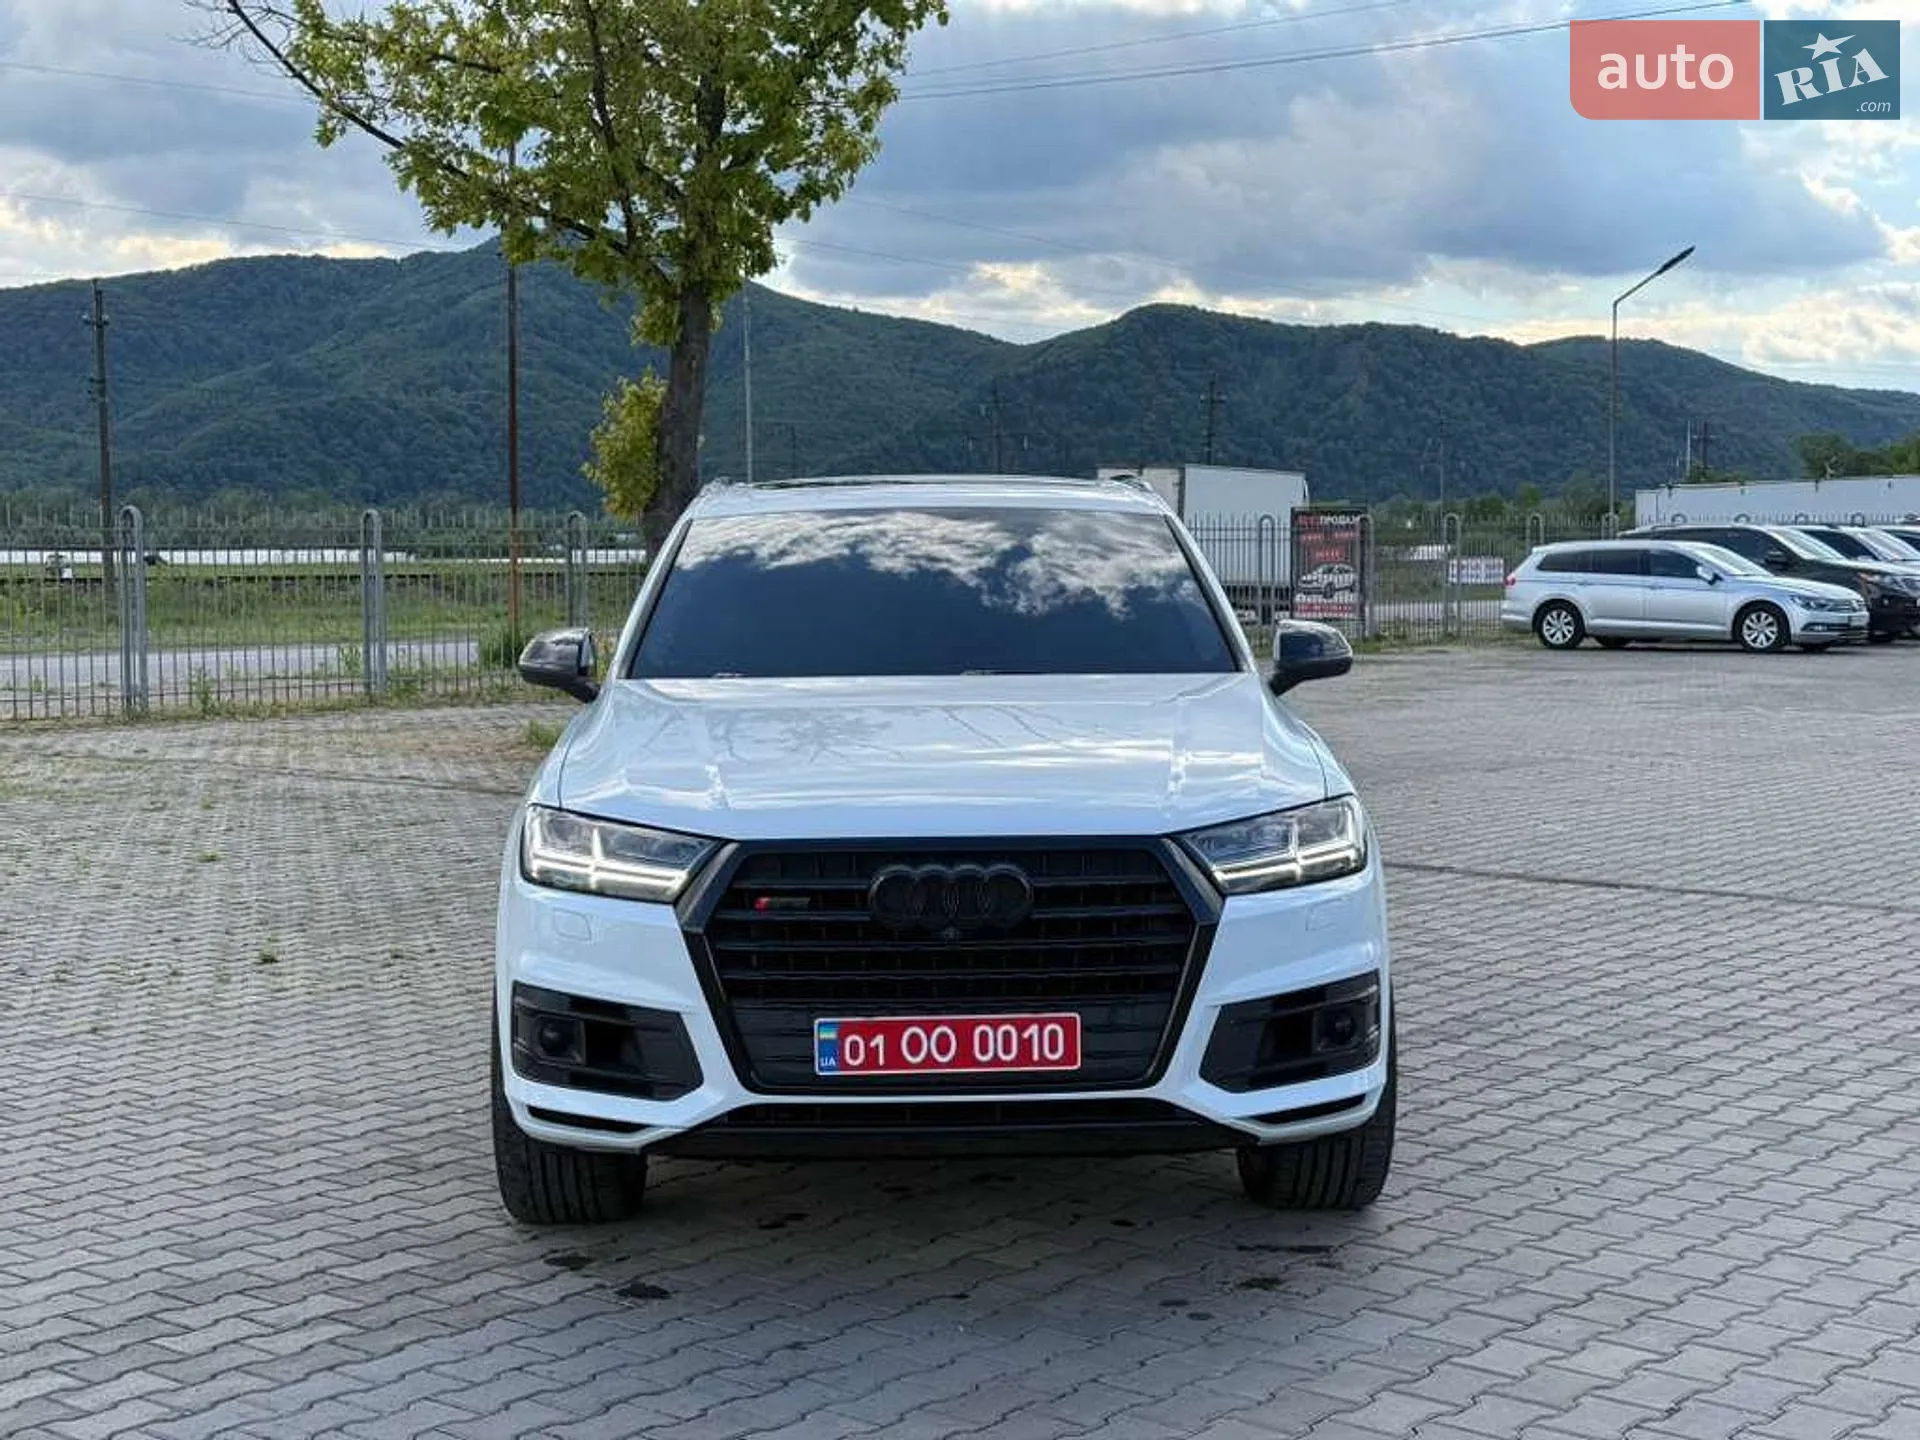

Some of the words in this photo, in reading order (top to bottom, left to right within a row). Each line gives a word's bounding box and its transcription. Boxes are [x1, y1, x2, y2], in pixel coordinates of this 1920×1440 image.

[844, 1034, 885, 1066] 01
[973, 1023, 1065, 1062] 0010
[819, 1057, 836, 1067] UA
